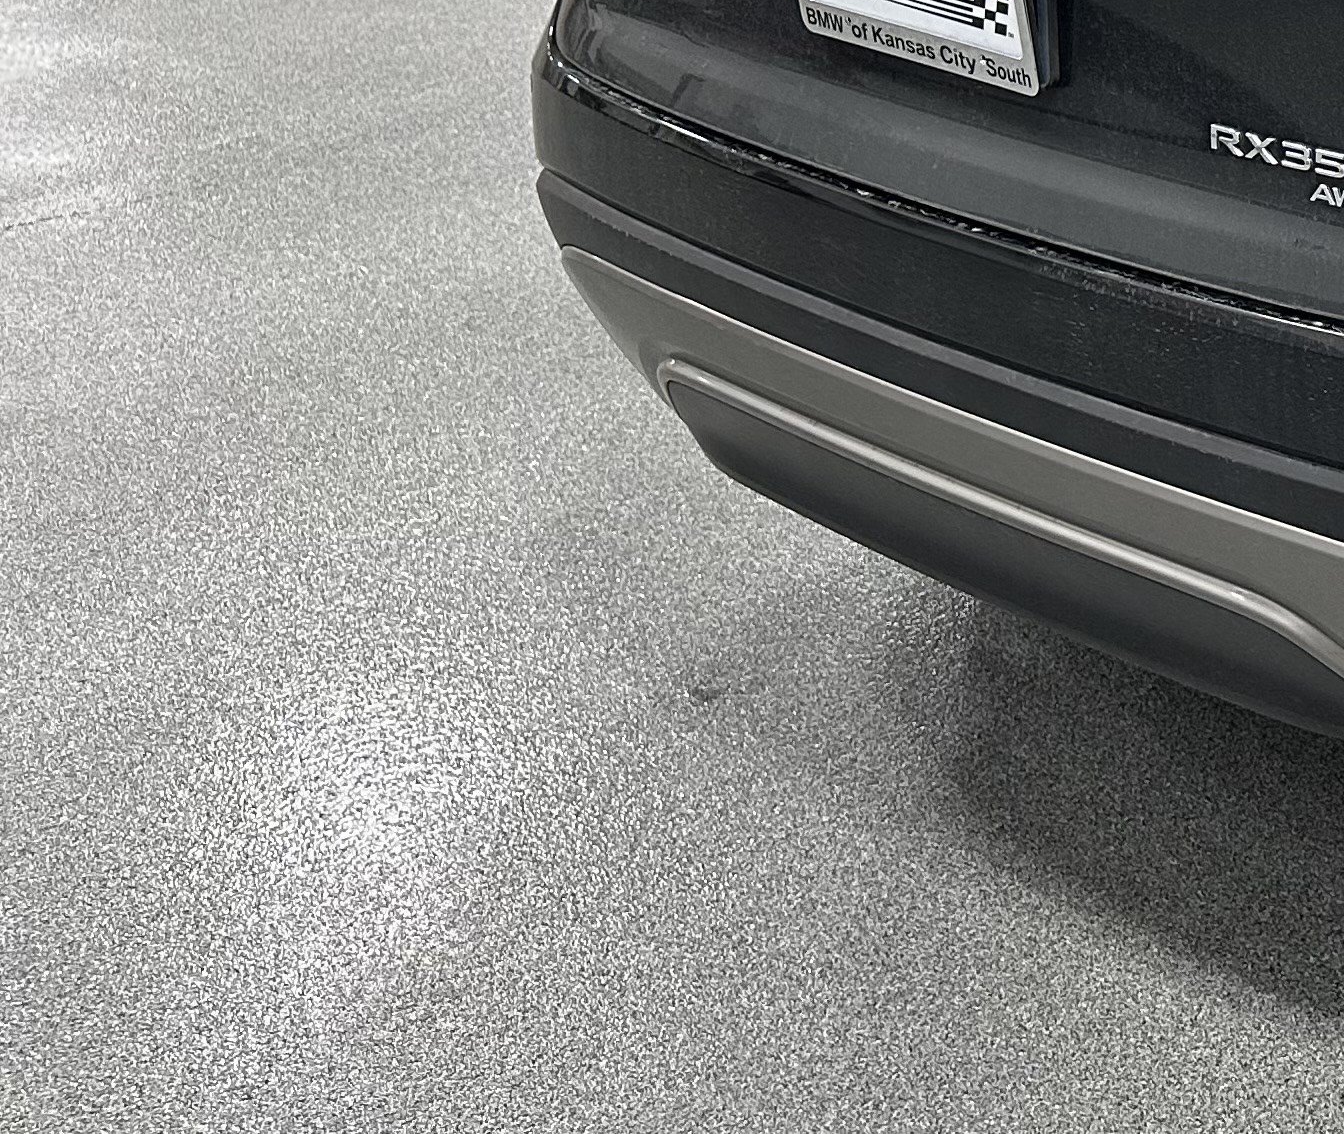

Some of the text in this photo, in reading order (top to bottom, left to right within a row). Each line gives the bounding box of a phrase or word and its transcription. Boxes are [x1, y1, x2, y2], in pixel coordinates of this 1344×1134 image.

[805, 7, 1033, 89] BMW of Kansas City South
